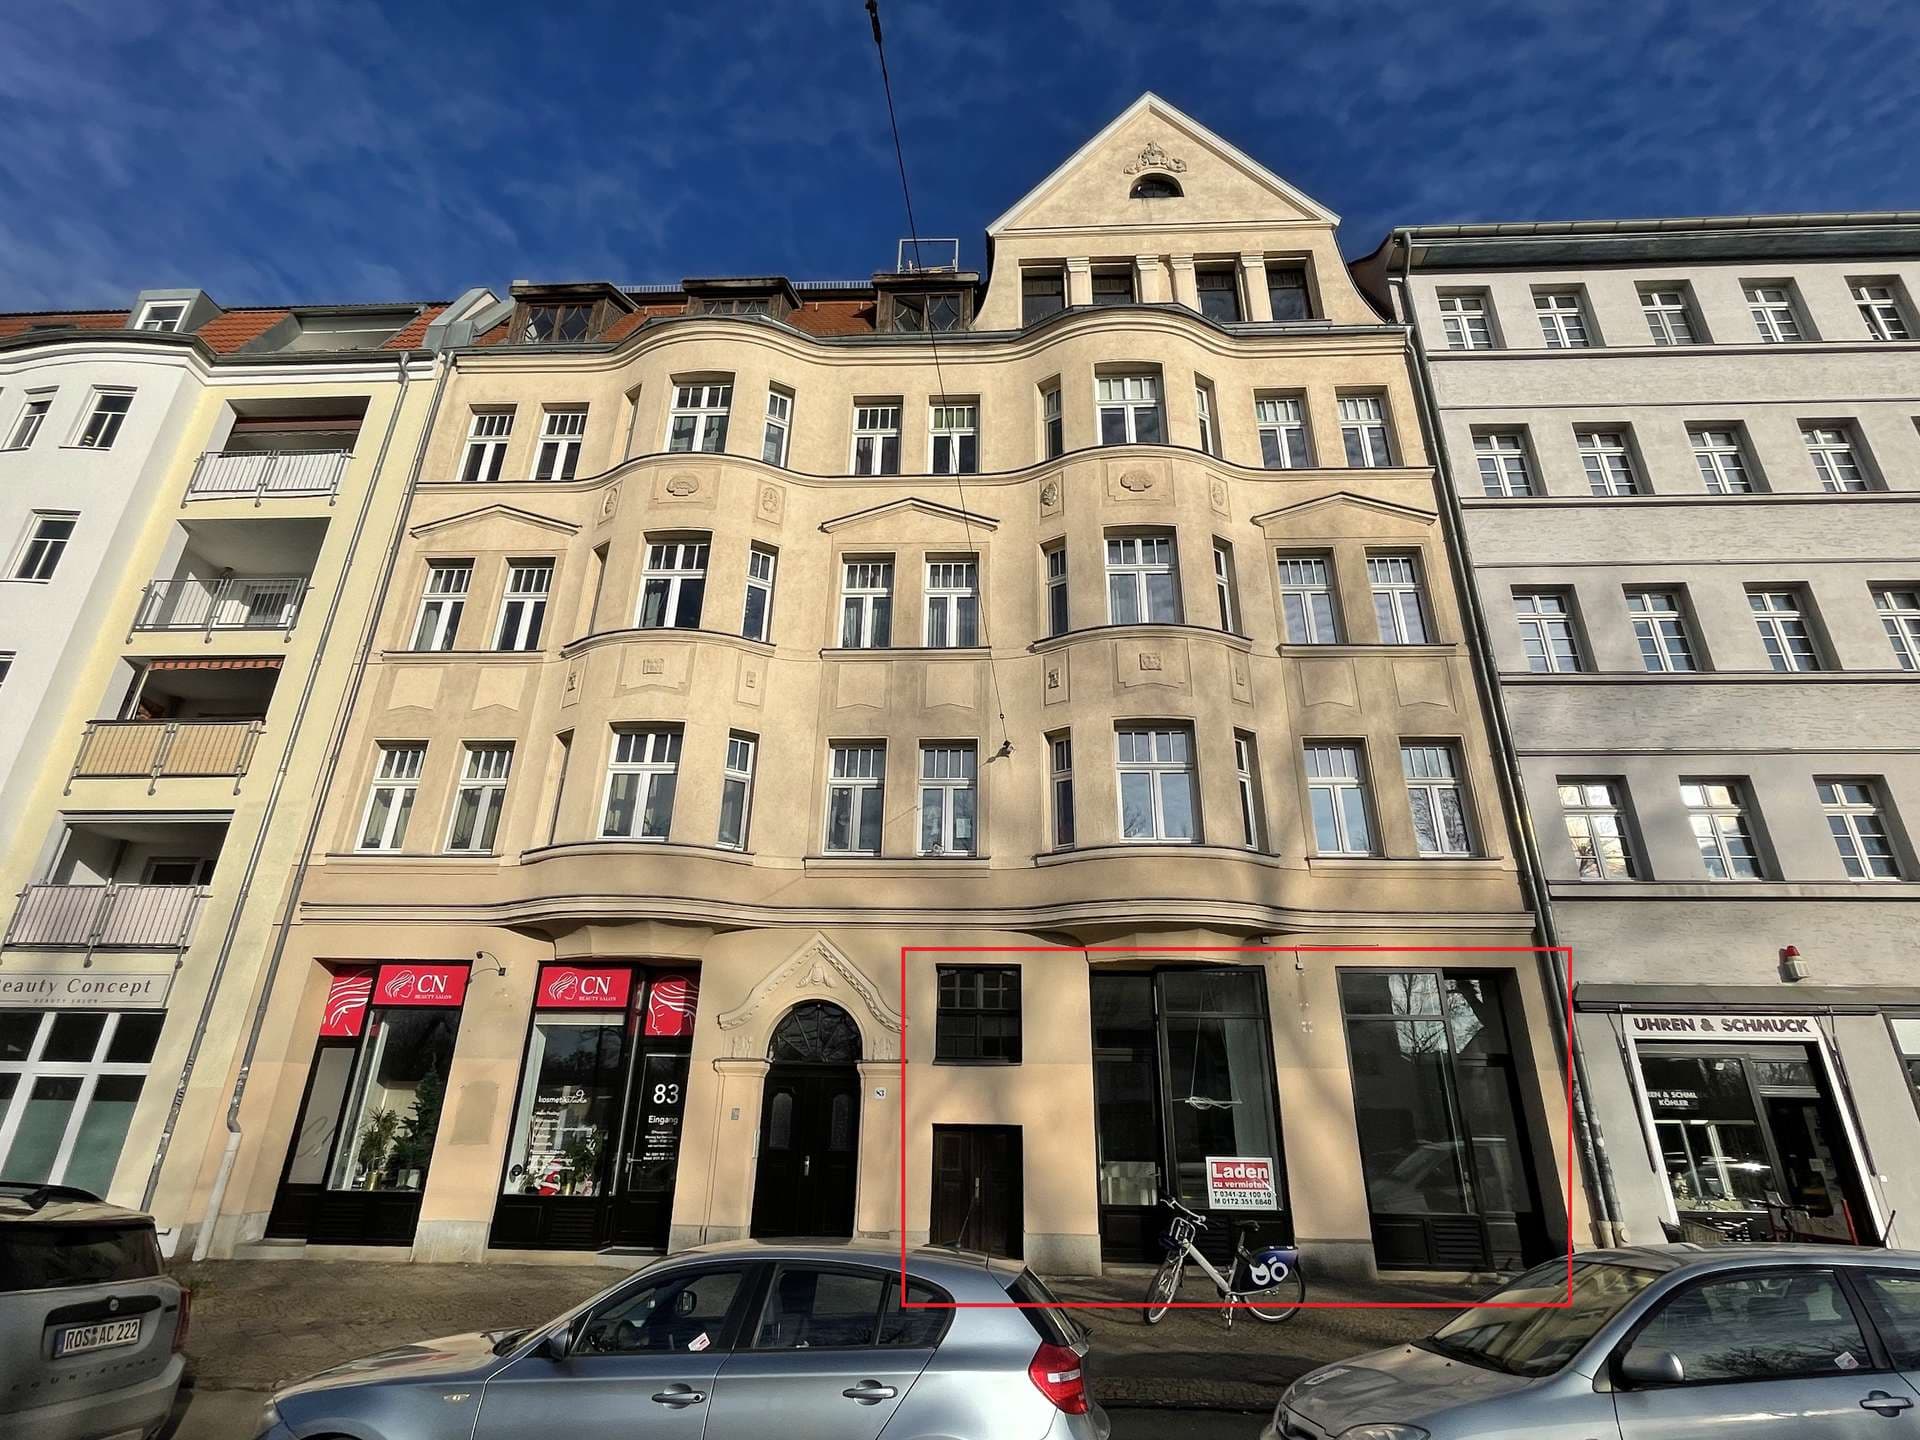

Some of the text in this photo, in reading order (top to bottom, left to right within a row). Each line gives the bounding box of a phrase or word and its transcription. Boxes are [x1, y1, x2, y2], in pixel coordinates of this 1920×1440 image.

[0, 978, 152, 997] eauty Concept
[417, 974, 448, 993] CN
[580, 976, 611, 995] CN
[1633, 1017, 1811, 1032] UHREN & SCHMUCK
[653, 1083, 679, 1104] 83
[648, 1115, 679, 1125] Eingang
[1212, 1163, 1269, 1179] Laden
[65, 1321, 139, 1350] ROS AC 222
